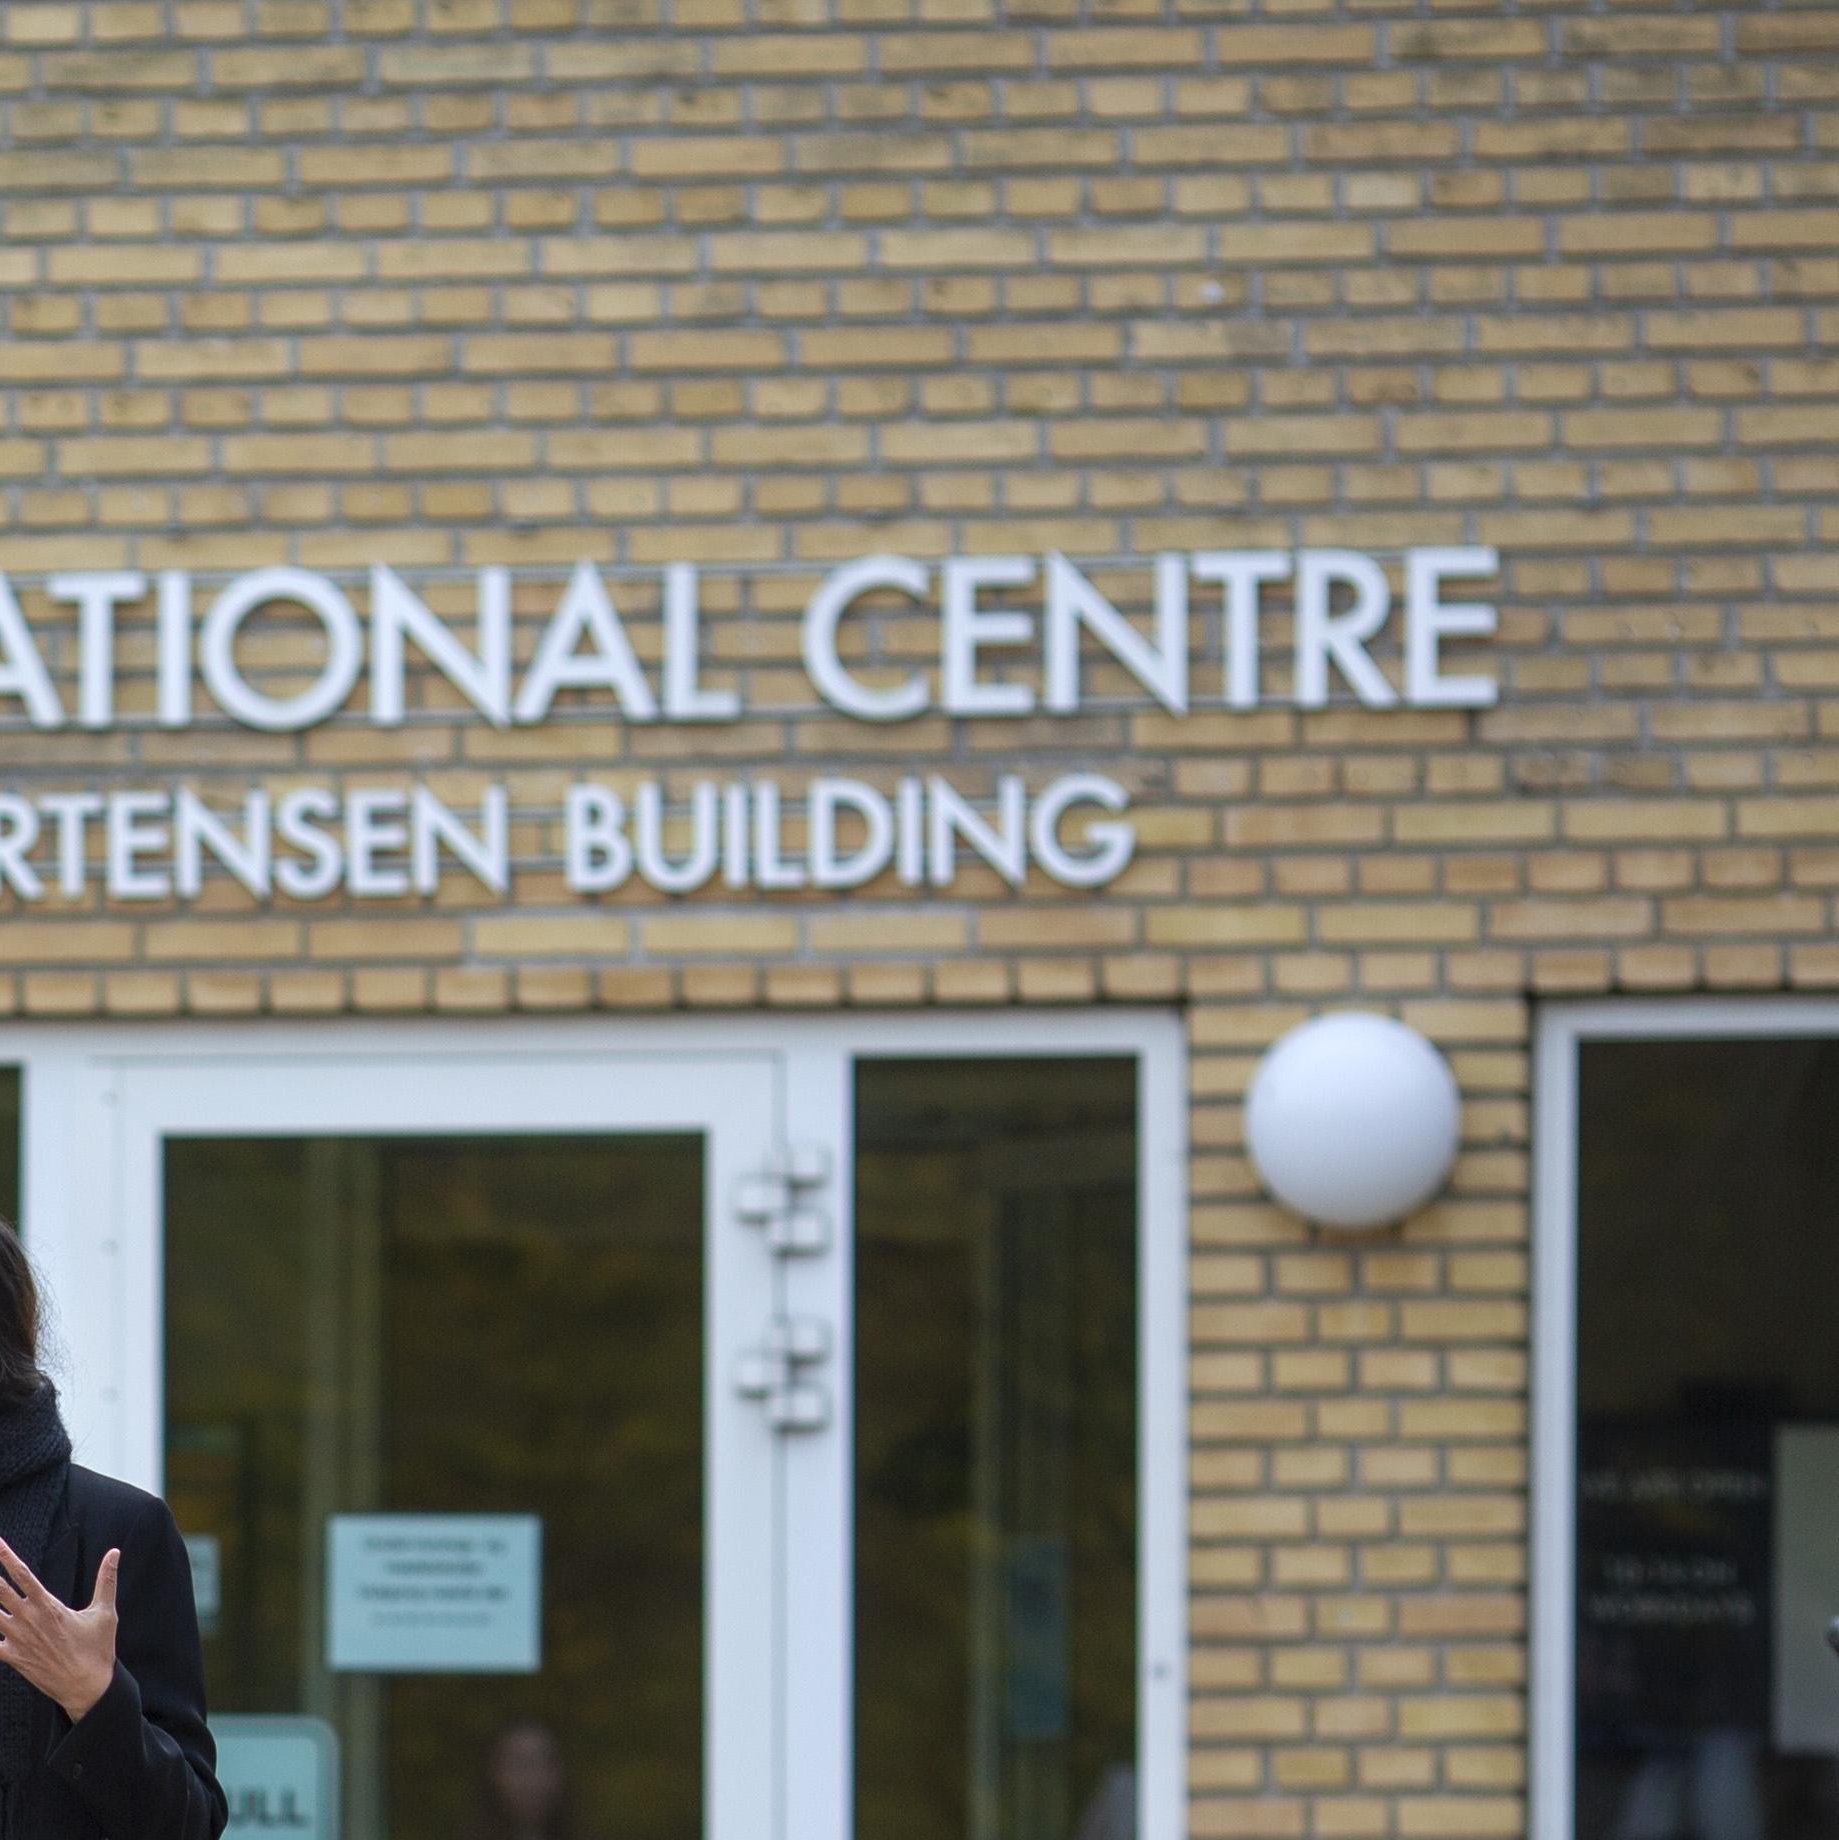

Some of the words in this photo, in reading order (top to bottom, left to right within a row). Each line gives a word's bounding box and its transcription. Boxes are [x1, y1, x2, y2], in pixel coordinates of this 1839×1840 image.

[798, 545, 1499, 717] CENTRE
[562, 773, 1138, 891] BUILDING
[228, 1788, 310, 1829] ULL
